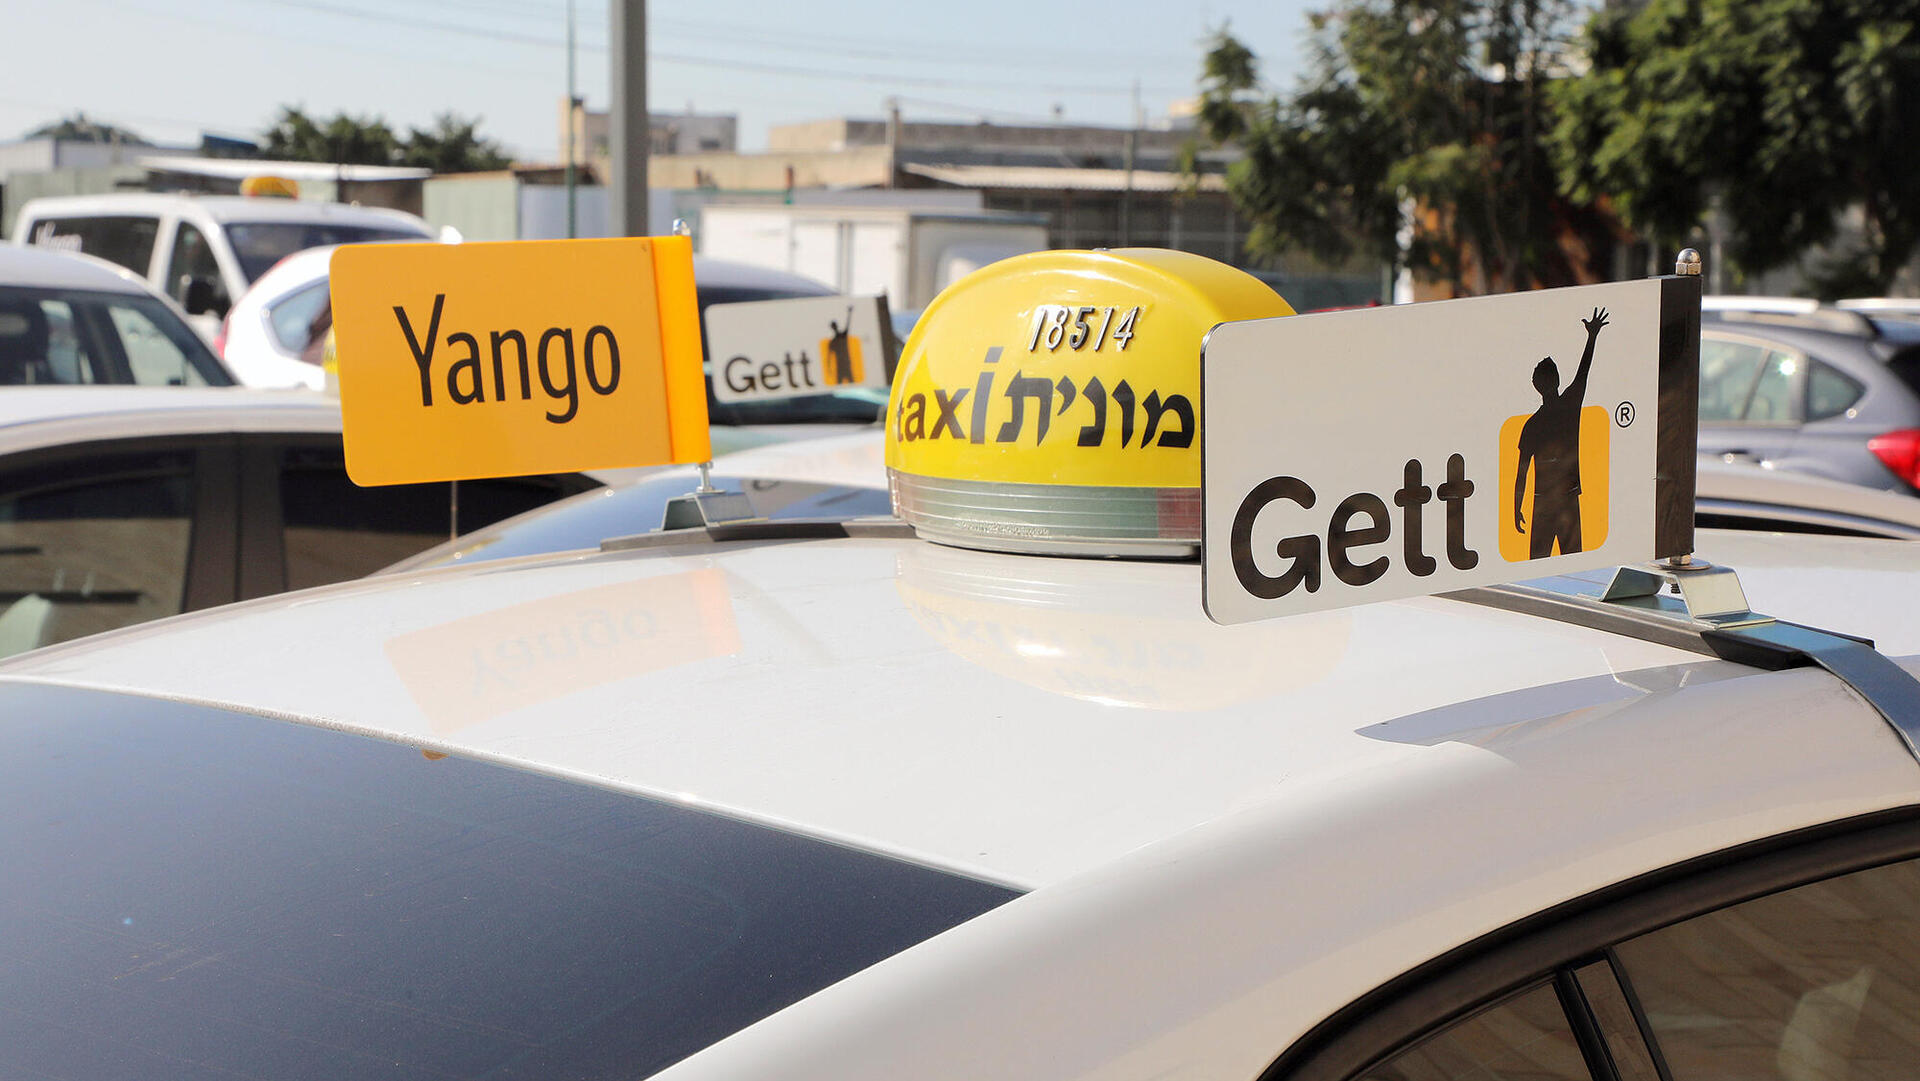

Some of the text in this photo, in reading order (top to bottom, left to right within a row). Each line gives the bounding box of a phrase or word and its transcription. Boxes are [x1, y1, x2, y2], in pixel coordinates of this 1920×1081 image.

[392, 293, 621, 425] Yango
[724, 350, 815, 394] Gett
[1027, 305, 1141, 353] 18514
[897, 346, 1004, 445] taxi
[995, 368, 1196, 450] מונית
[1230, 452, 1480, 600] Gett
